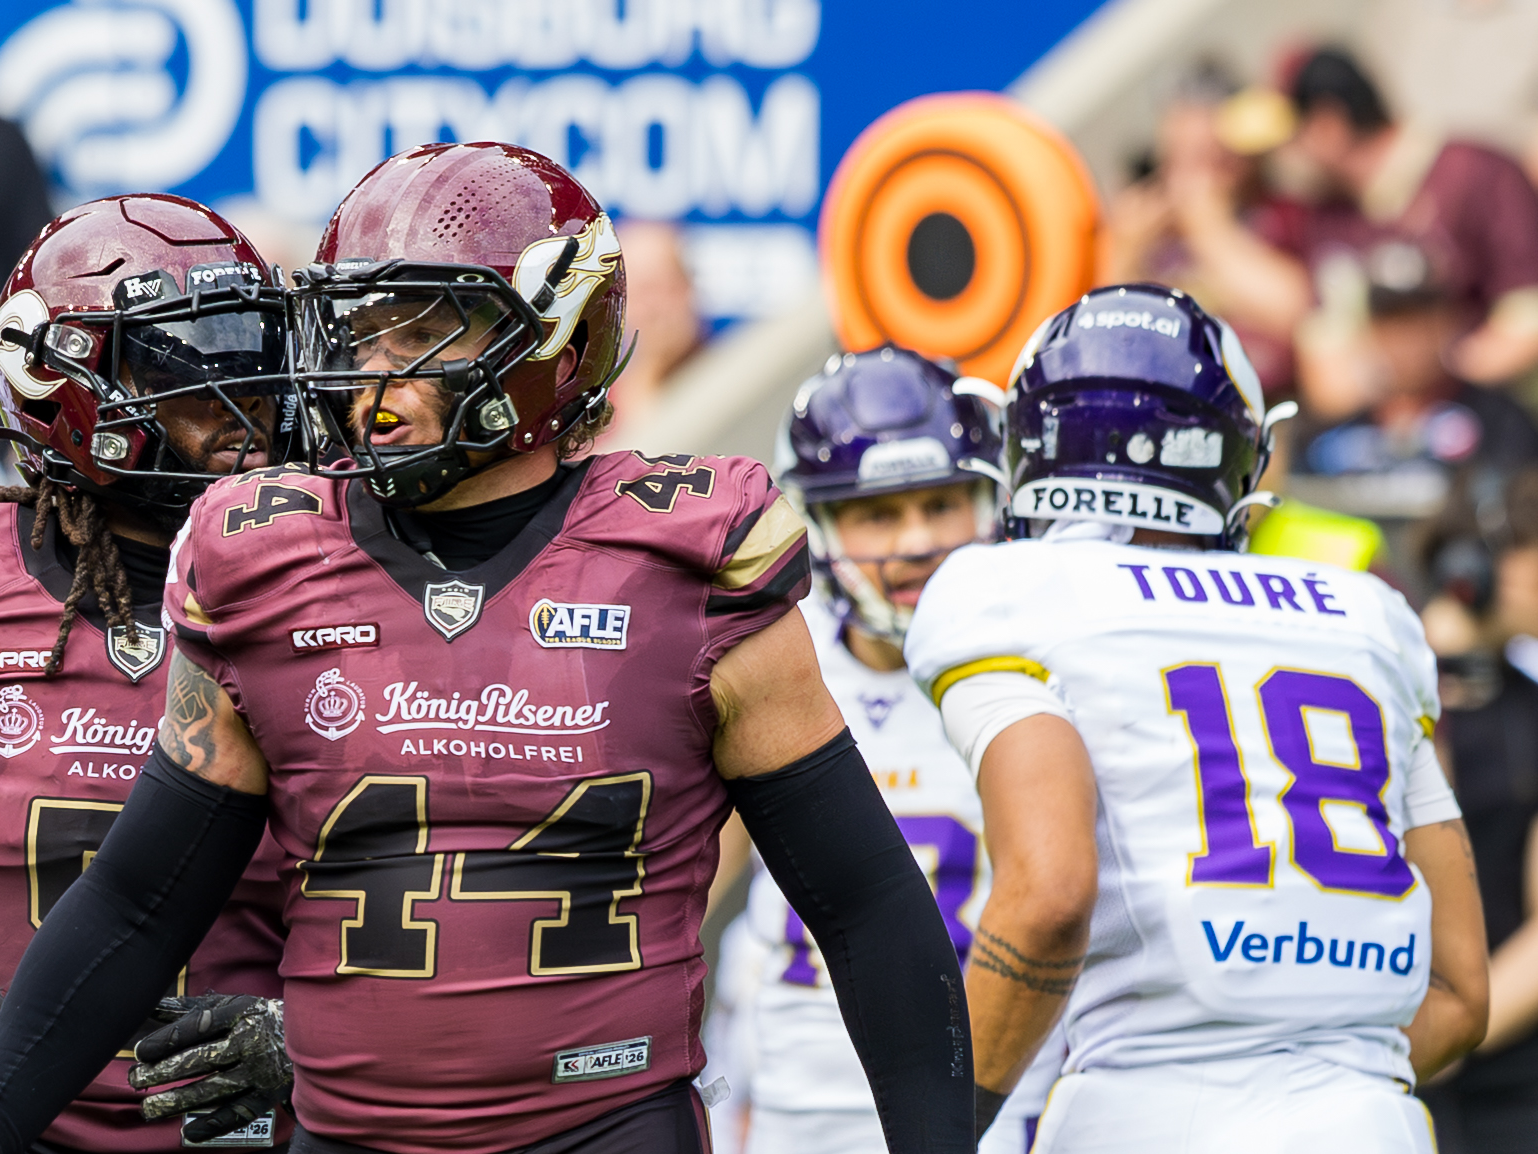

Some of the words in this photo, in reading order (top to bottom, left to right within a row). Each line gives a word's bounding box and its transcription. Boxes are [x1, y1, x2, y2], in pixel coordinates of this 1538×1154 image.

[280, 393, 298, 434] Ridde
[1032, 486, 1195, 526] FORELLE
[1117, 563, 1347, 617] TOURÉ
[545, 607, 625, 639] AFLE
[400, 738, 584, 763] ALKOHOLFREI
[1159, 660, 1419, 901] 18
[295, 770, 655, 979] 44
[1201, 919, 1417, 978] Verbund
[591, 1053, 622, 1069] AFLE
